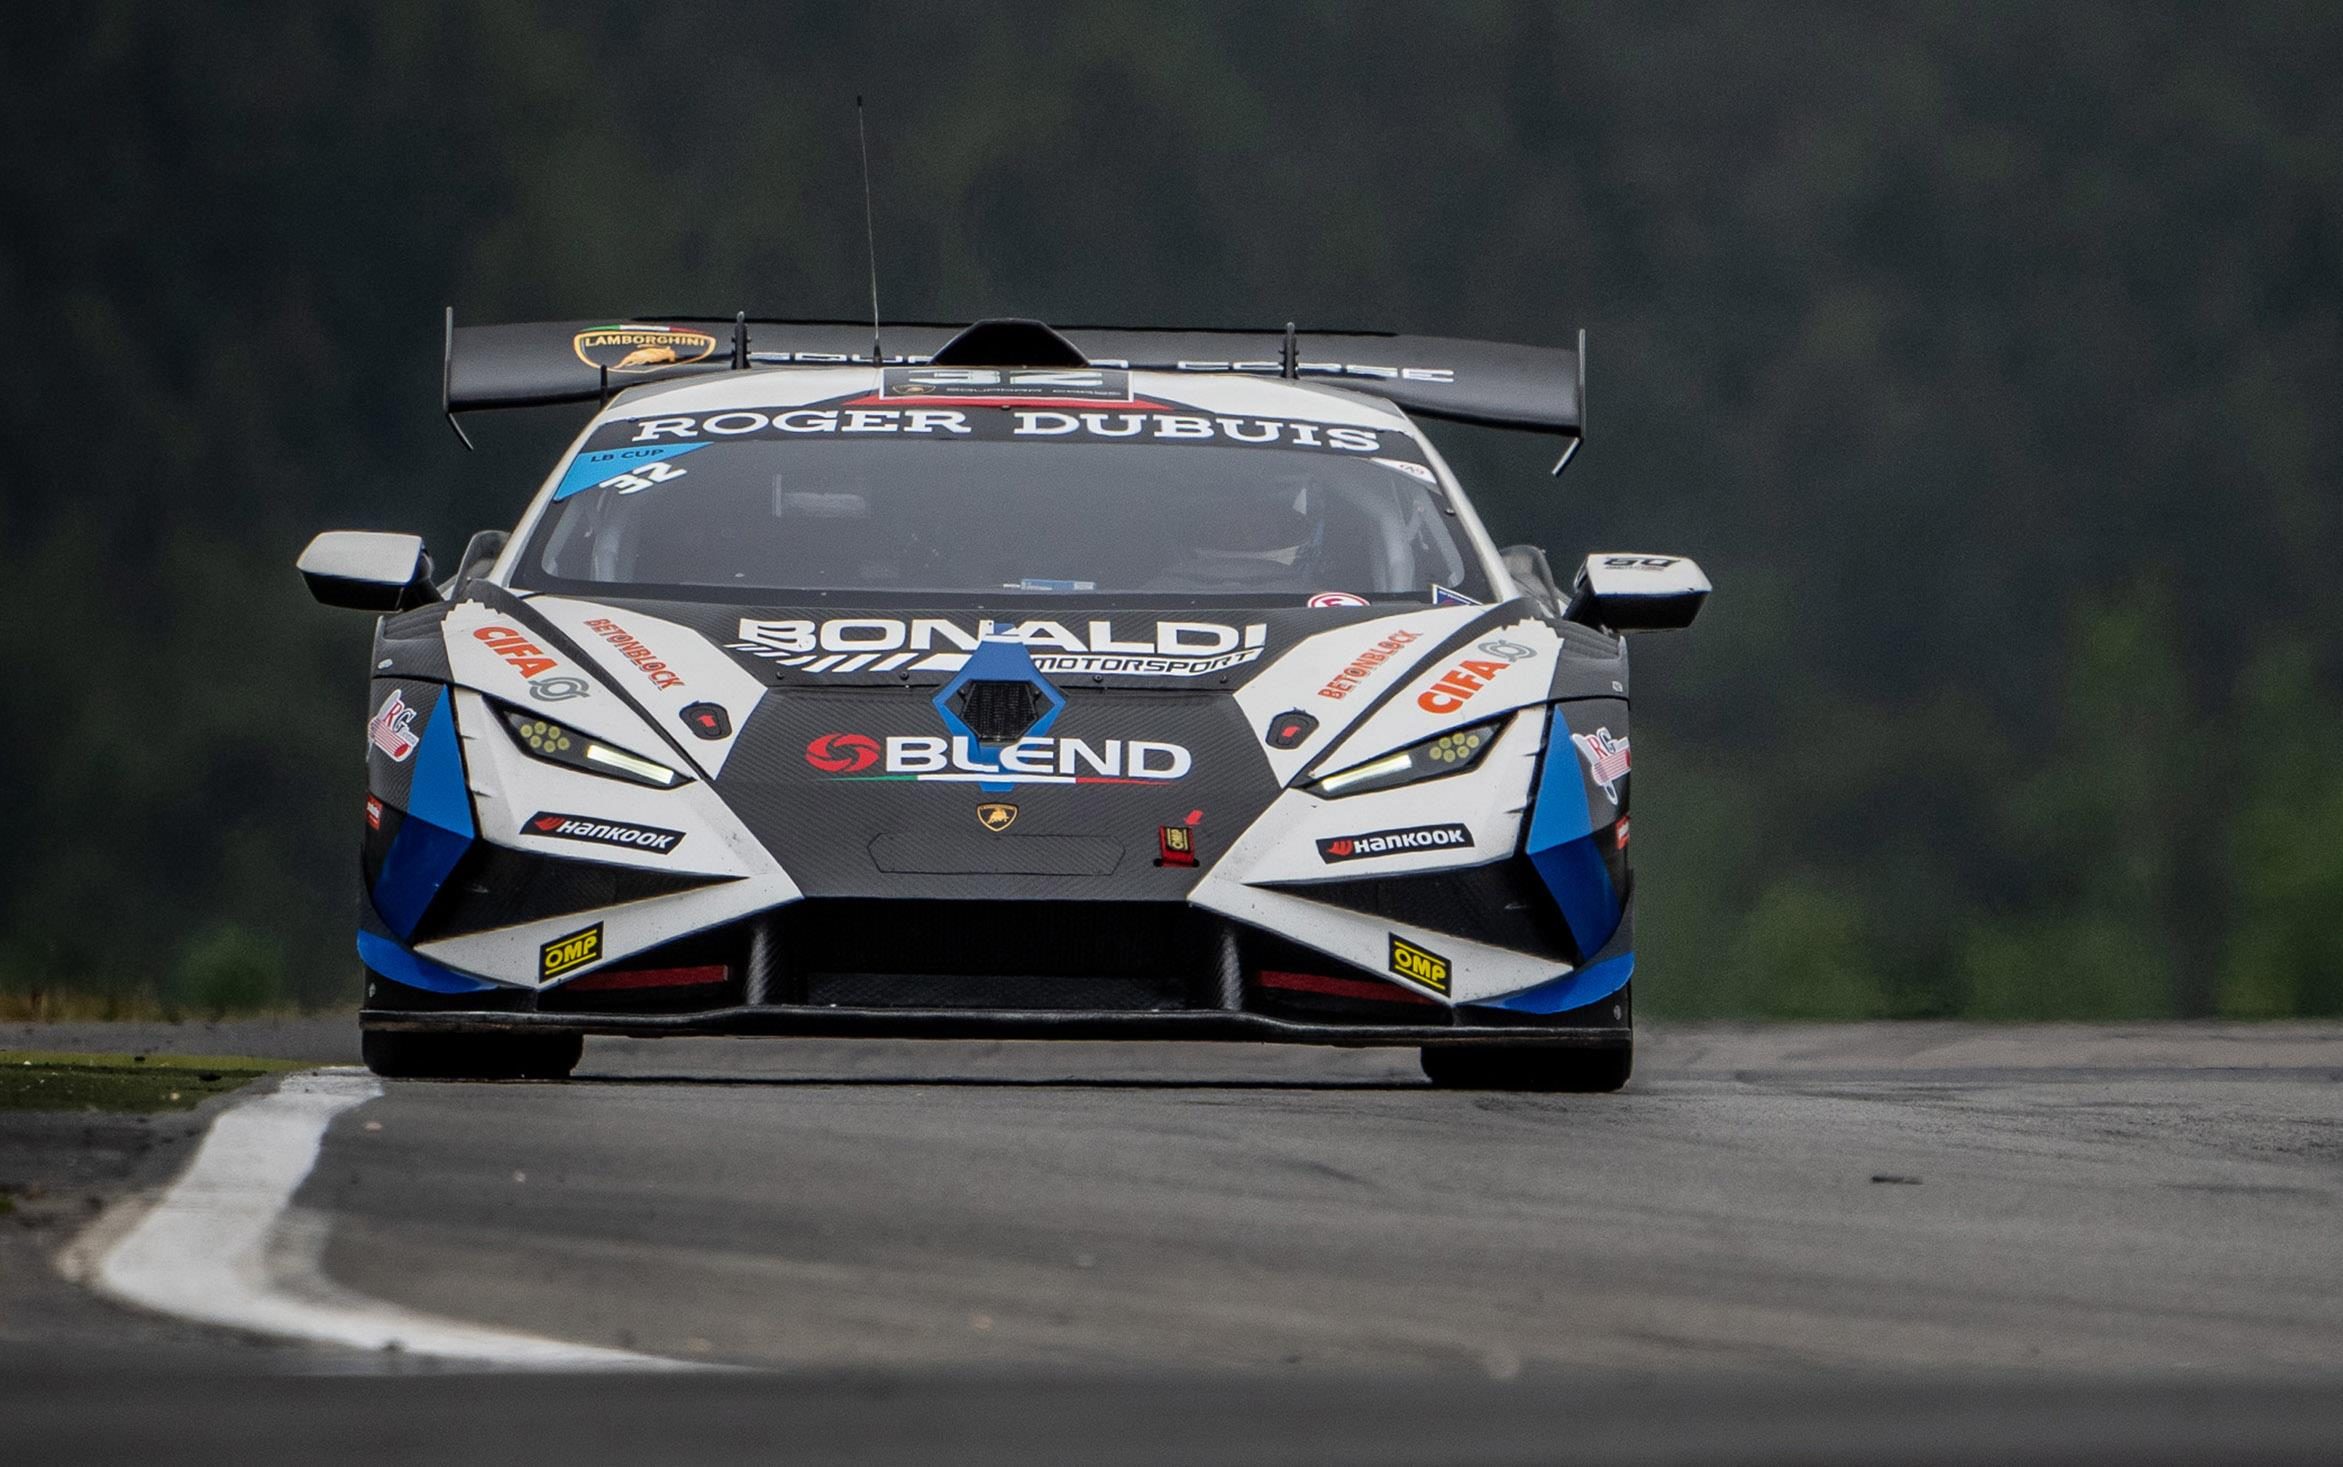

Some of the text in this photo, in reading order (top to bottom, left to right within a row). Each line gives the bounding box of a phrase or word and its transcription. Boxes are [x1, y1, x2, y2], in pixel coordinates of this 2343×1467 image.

[585, 335, 705, 347] LAMBORGHINI
[909, 369, 1102, 386] 32
[632, 409, 1380, 452] ROGER DUBUIS
[591, 449, 665, 463] LB CUP
[598, 461, 688, 495] 32
[473, 626, 559, 680] CIFA
[738, 617, 1268, 654] BONALDI
[584, 618, 685, 691] BETONBLOCK
[1033, 650, 1257, 675] MOTORSPORT
[1318, 629, 1423, 700] BETONBLOCK
[1417, 660, 1511, 724] CIFA
[886, 735, 1193, 779] BLEND
[545, 935, 597, 967] OMP
[1394, 949, 1447, 982] OMP
